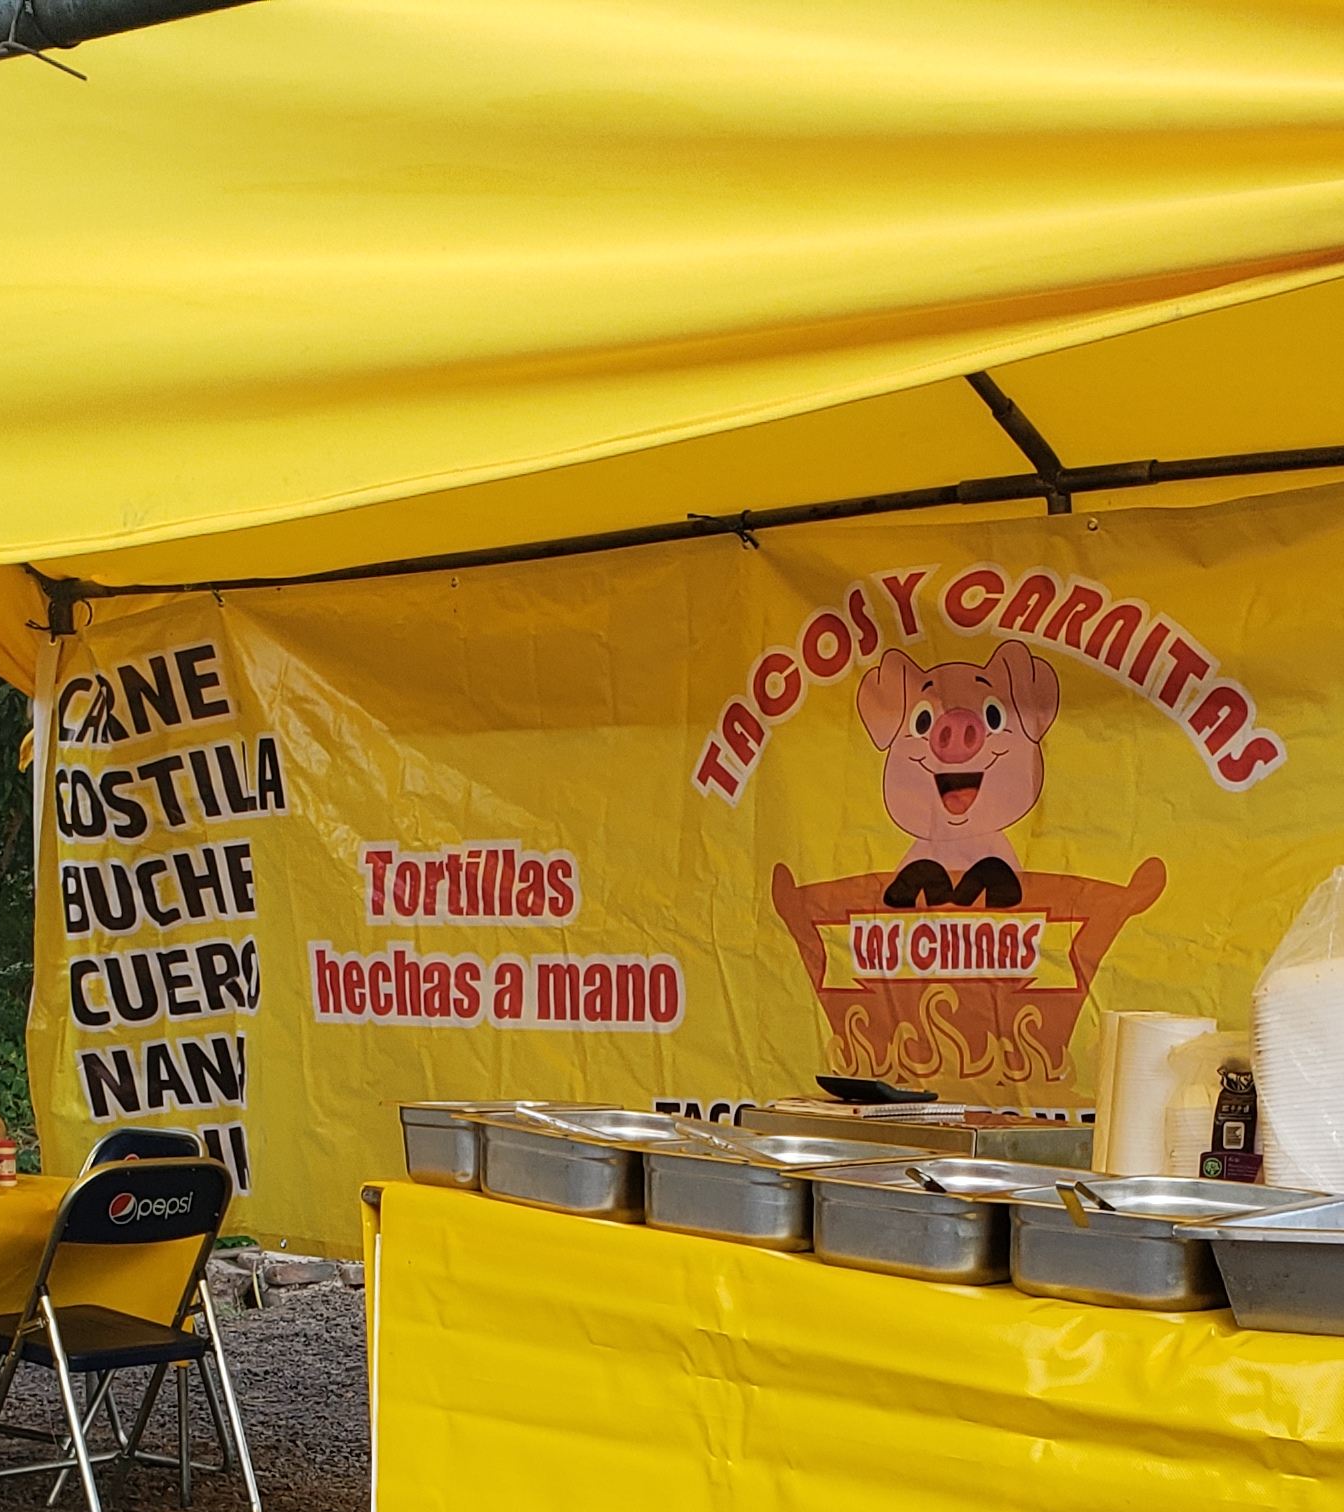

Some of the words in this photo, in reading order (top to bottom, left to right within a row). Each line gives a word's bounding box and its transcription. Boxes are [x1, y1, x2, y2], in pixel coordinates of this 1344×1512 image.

[696, 589, 880, 798] TACOS
[882, 571, 931, 636] Y
[943, 569, 1279, 784] CARNITAS
[63, 843, 256, 934] BUCHE
[365, 848, 575, 918] Tortillas
[70, 940, 260, 1026] CUERO
[316, 949, 480, 1019] hechas
[494, 963, 523, 1019] a
[536, 961, 680, 1023] mano
[854, 923, 901, 972] LAS
[910, 921, 1042, 971] CHINAS
[81, 1035, 246, 1119] NAN
[136, 1191, 194, 1221] pepsi
